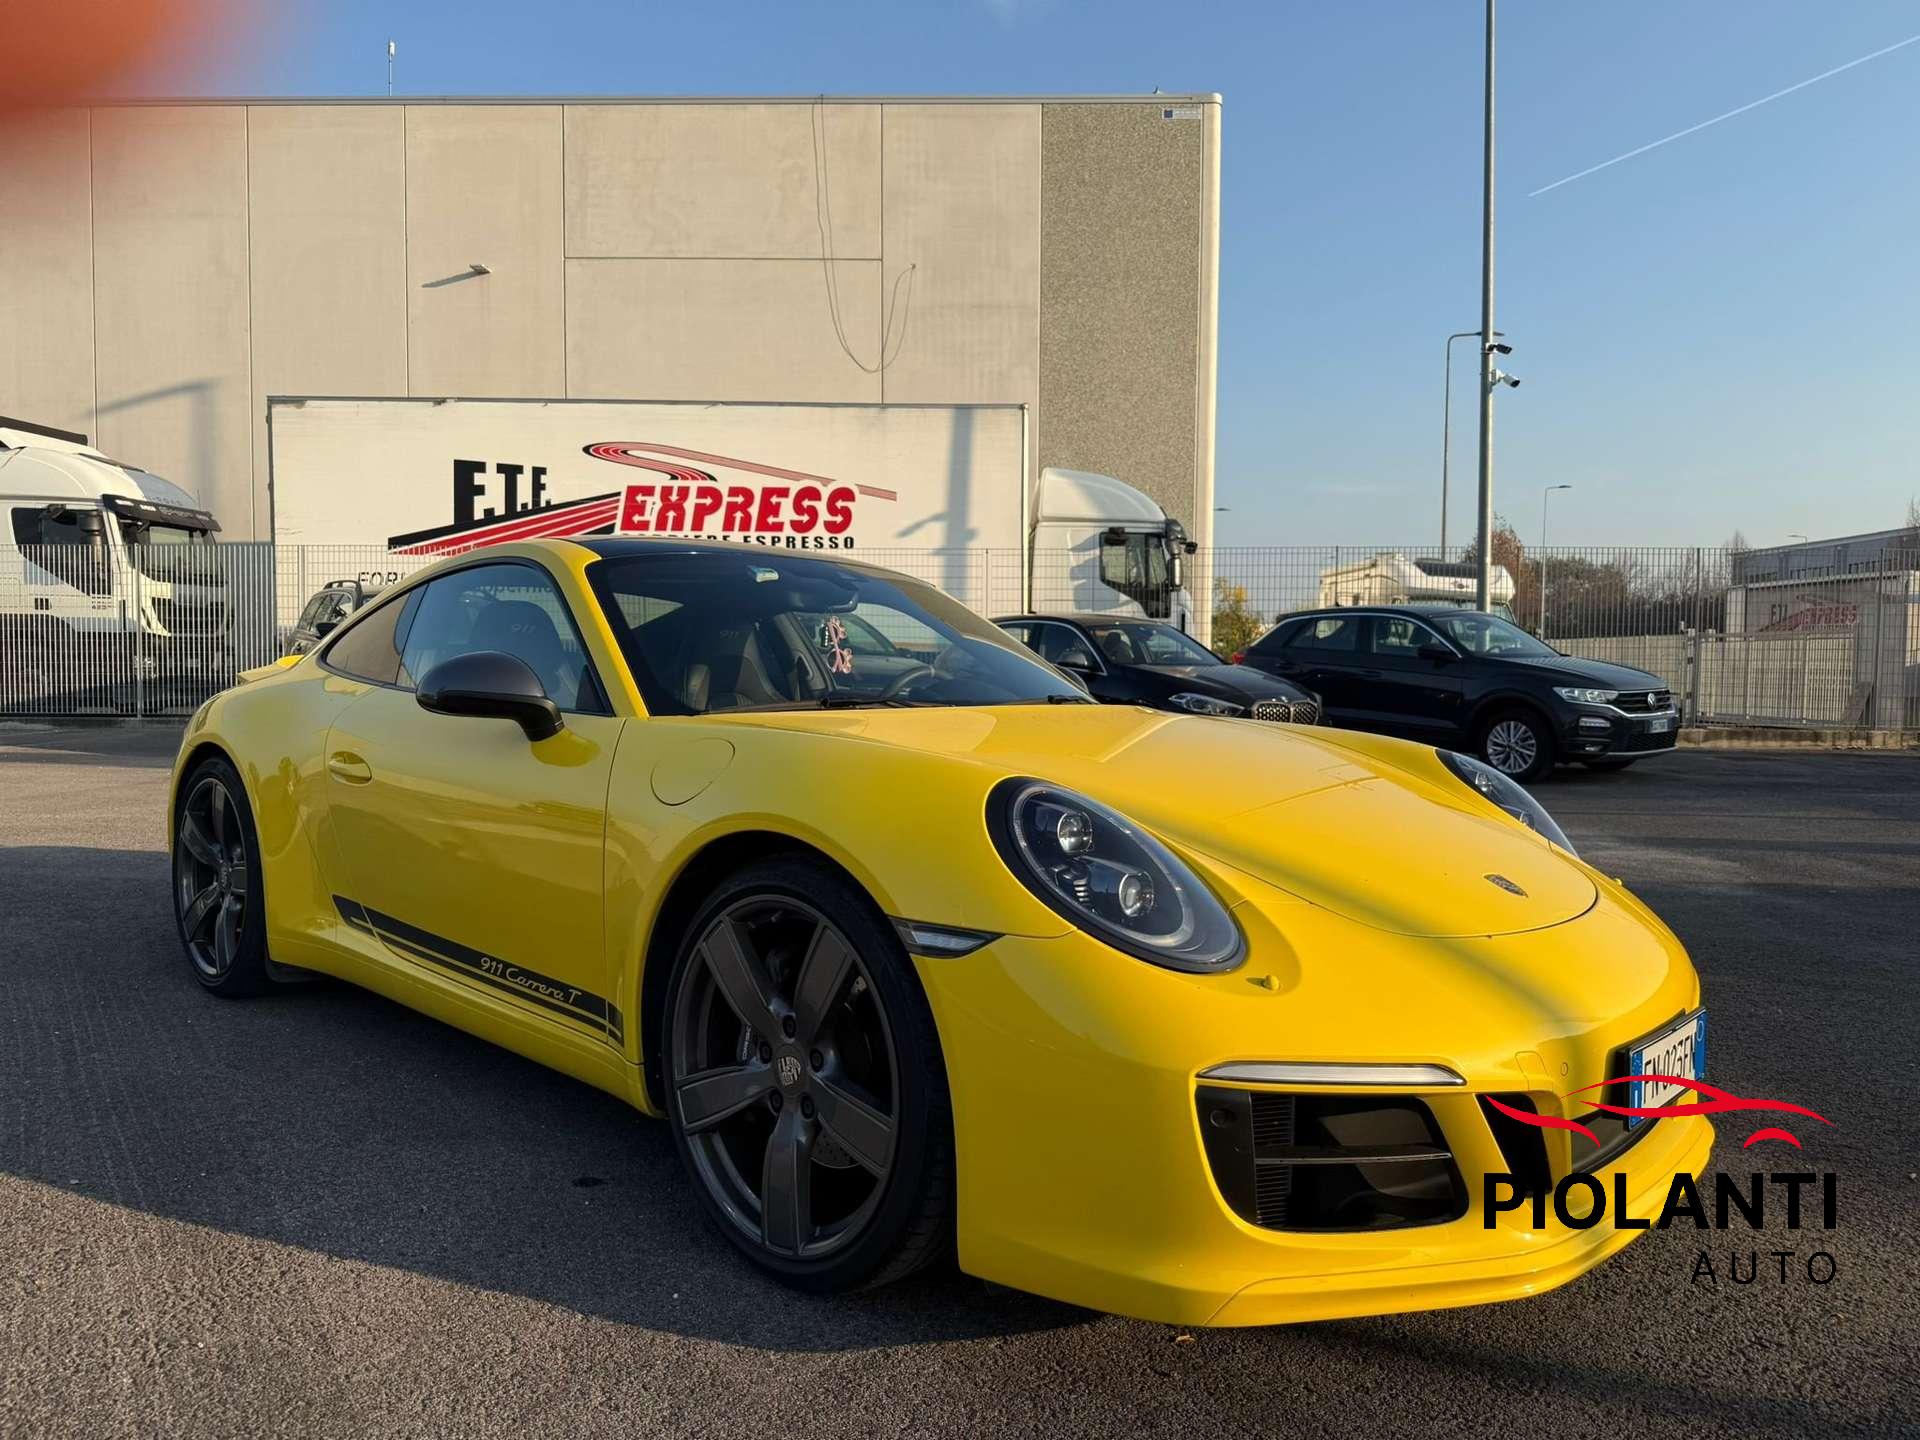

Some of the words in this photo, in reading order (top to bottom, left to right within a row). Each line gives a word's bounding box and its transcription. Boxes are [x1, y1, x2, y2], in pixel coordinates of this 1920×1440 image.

[620, 485, 856, 534] EXPRESS
[480, 957, 503, 976] 911
[505, 967, 564, 1001] Carrera
[568, 988, 582, 1004] T
